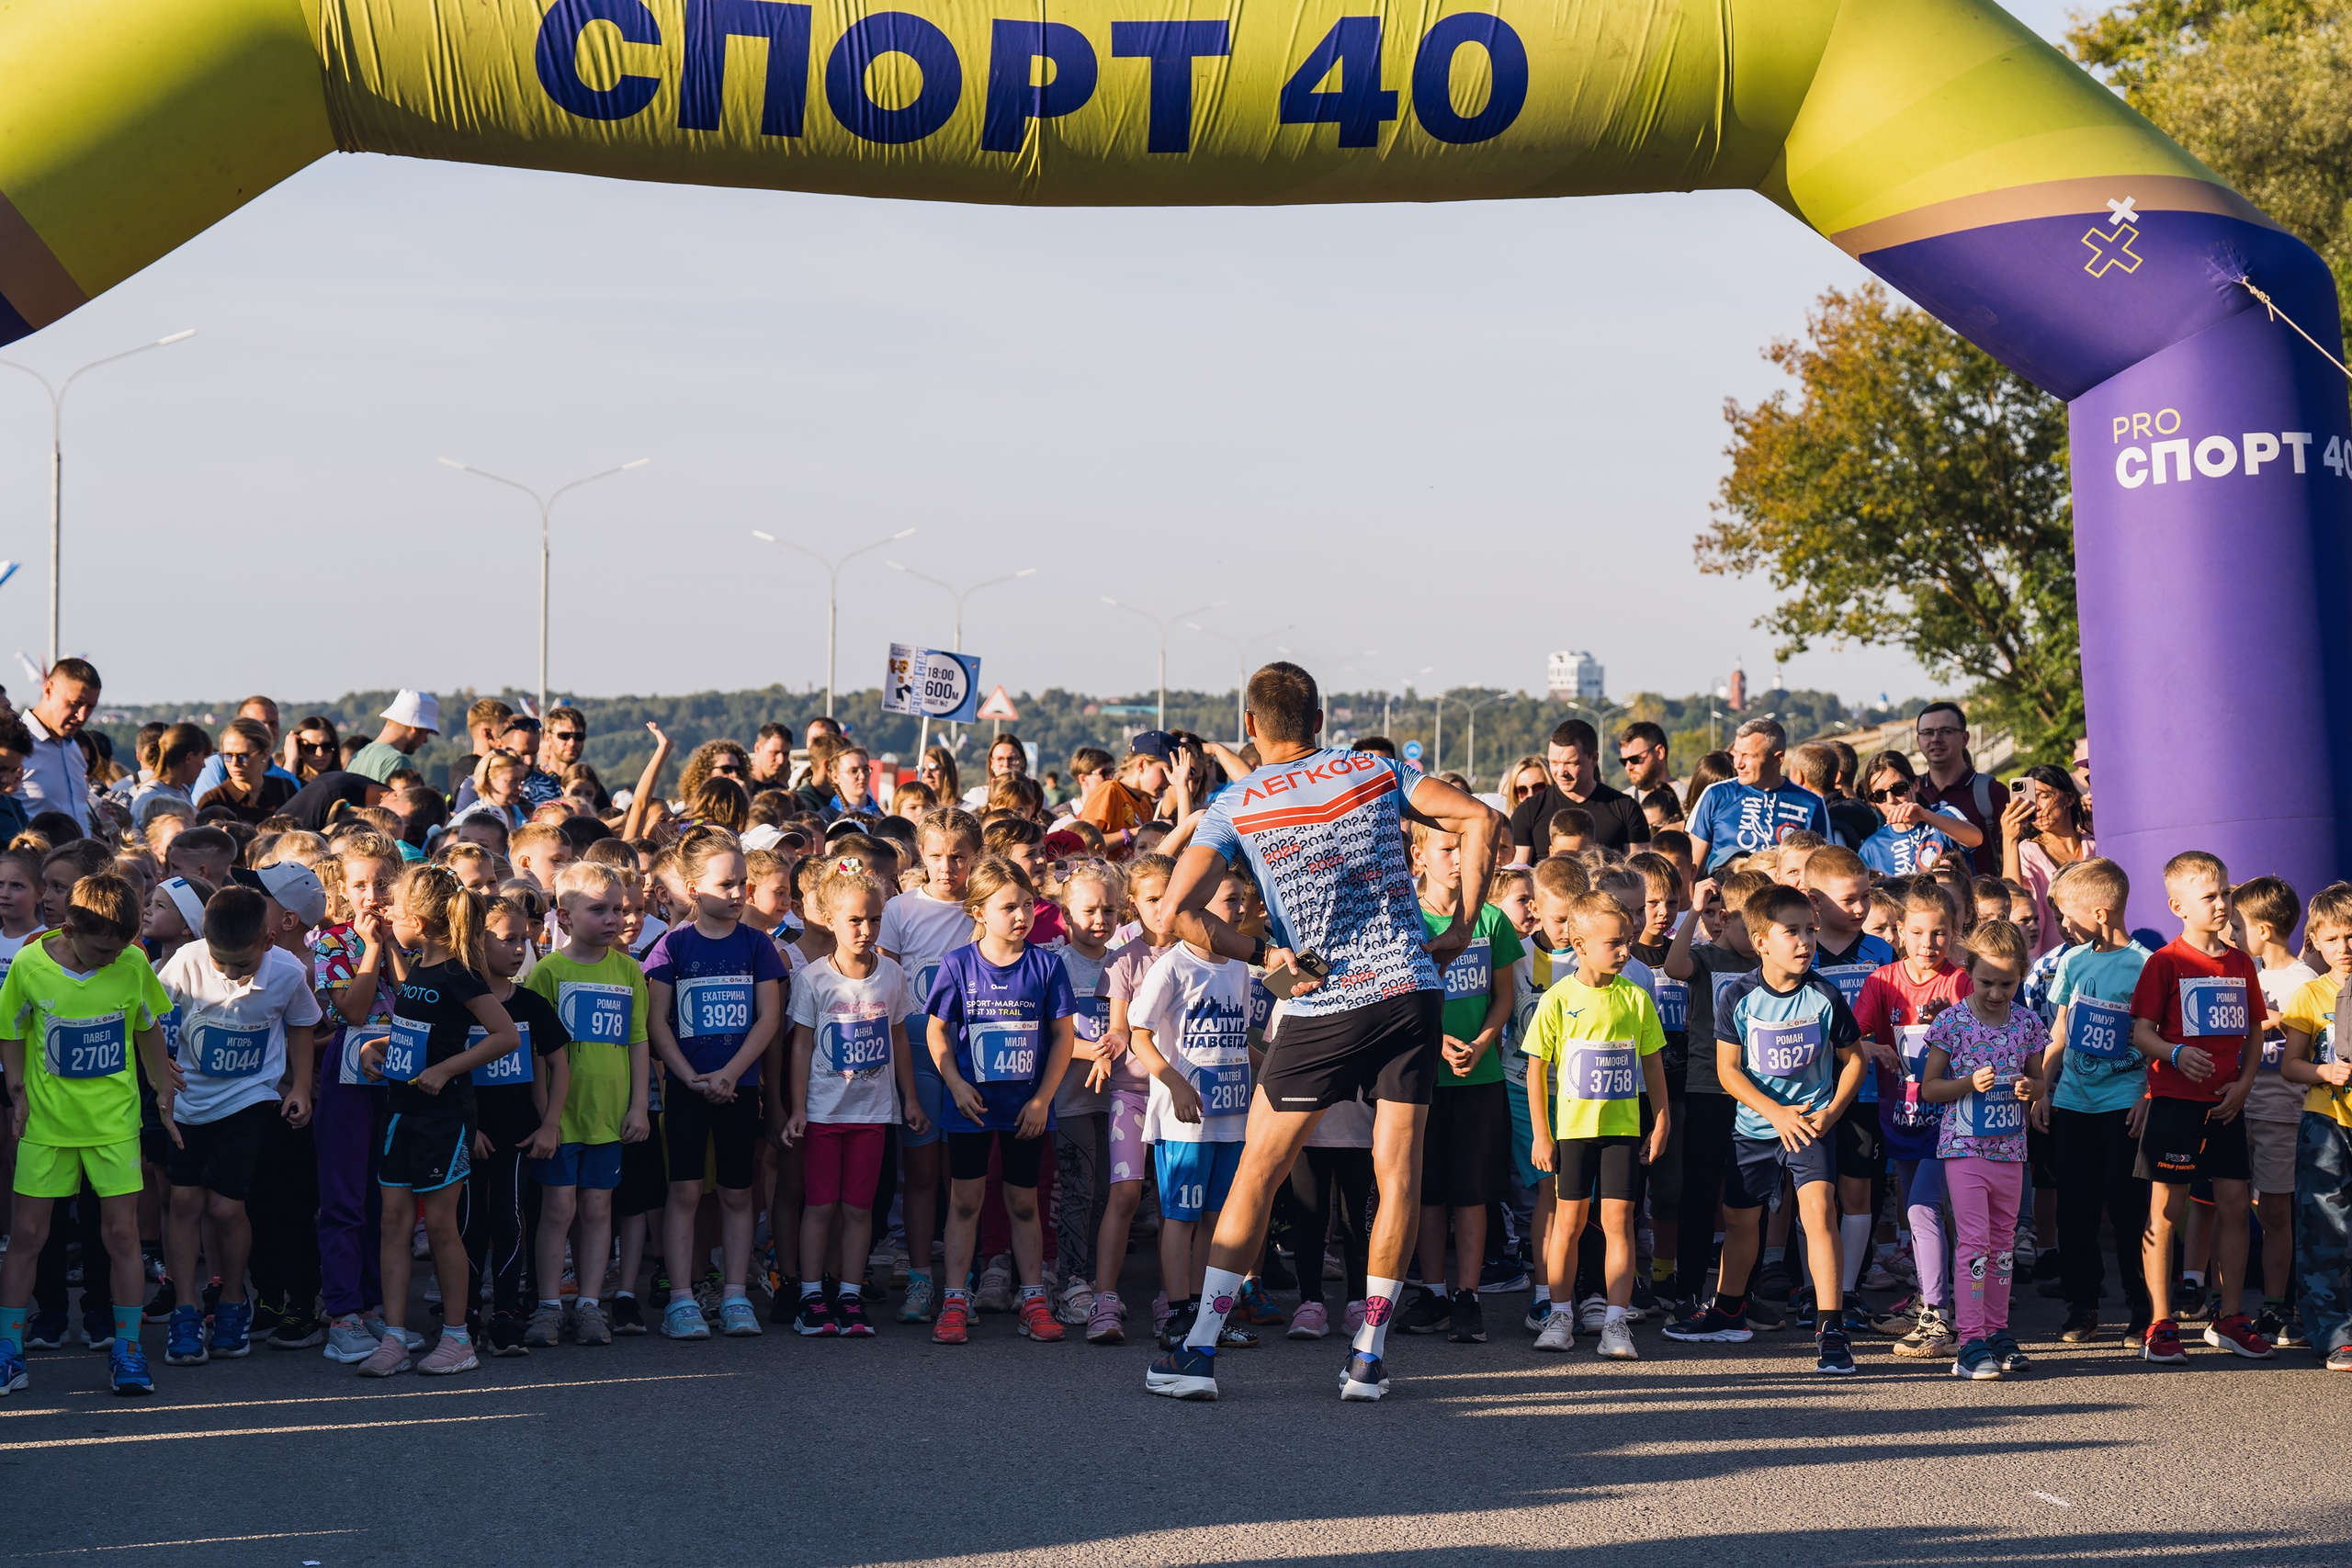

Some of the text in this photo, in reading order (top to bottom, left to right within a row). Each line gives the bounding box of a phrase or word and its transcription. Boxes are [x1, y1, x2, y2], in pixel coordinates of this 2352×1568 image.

[535, 0, 1529, 153] СПОРТ 40
[2113, 408, 2181, 444] PRO
[2115, 432, 2312, 489] СПОРТ
[928, 667, 955, 681] 18:00
[1366, 801, 1395, 814] 2021
[1333, 814, 1369, 832] 2024
[1372, 816, 1396, 828] 2016
[1737, 797, 1763, 852] СКИЙ
[1300, 831, 1335, 851] 2014
[1340, 829, 1372, 845] 2019
[1375, 832, 1399, 845] 2024
[1261, 836, 1298, 857] 2022
[1263, 843, 1301, 864] 2026
[1344, 845, 1377, 862] 2014
[1381, 848, 1402, 861] 2019
[1270, 851, 1300, 871] 2017
[1305, 847, 1341, 866] 2022
[1308, 854, 1345, 874] 2026
[1275, 865, 1309, 887] 2025
[1314, 863, 1344, 881] 2017
[1348, 861, 1382, 875] 2022
[1385, 863, 1407, 876] 2014
[1281, 882, 1315, 902] 2020
[1316, 876, 1349, 897] 2025
[1352, 877, 1383, 892] 2017
[1288, 897, 1317, 916] 2015
[1354, 891, 1387, 907] 2025
[1361, 920, 1392, 936] 2016
[1332, 953, 1364, 968] 2014
[1371, 948, 1401, 963] 2019
[1452, 953, 1478, 966] СТЕПАН
[1376, 962, 1408, 977] 2014
[1340, 970, 1376, 988] 2026
[1345, 977, 1375, 994] 2017
[1380, 975, 1414, 992] 2022
[1444, 965, 1487, 993] 3594
[596, 998, 621, 1010] РОМАН
[702, 990, 745, 1002] ЕКАТЕРИНА
[1312, 995, 1345, 1010] 2020
[1346, 991, 1384, 1010] 2025
[1662, 991, 1683, 1001] ПАВЕЛ
[2216, 992, 2237, 1003] РОМАН
[592, 1012, 623, 1037] 978
[703, 1003, 747, 1028] 3929
[2088, 1011, 2115, 1025] ТИМУР
[2209, 1006, 2245, 1029] 3838
[83, 1030, 111, 1044] ПАВЕЛ
[854, 1026, 873, 1038] АННА
[1775, 1032, 1804, 1045] РОМАН
[2081, 1024, 2116, 1051] 293
[226, 1036, 253, 1047] ИГОРЬ
[842, 1036, 885, 1065] 3822
[1004, 1036, 1027, 1047] МИЛА
[71, 1042, 120, 1071] 2702
[211, 1047, 261, 1072] 3044
[385, 1045, 413, 1075] 934
[487, 1052, 522, 1078] 954
[994, 1050, 1034, 1074] 4468
[1594, 1055, 1628, 1066] ТИМОФЕЙ
[1767, 1043, 1815, 1070] 3627
[1217, 1070, 1242, 1082] МАТВЕЙ
[1589, 1069, 1633, 1093] 3758
[1211, 1083, 1246, 1110] 2812
[1984, 1103, 2021, 1129] 2330
[1179, 1184, 1203, 1209] 10
